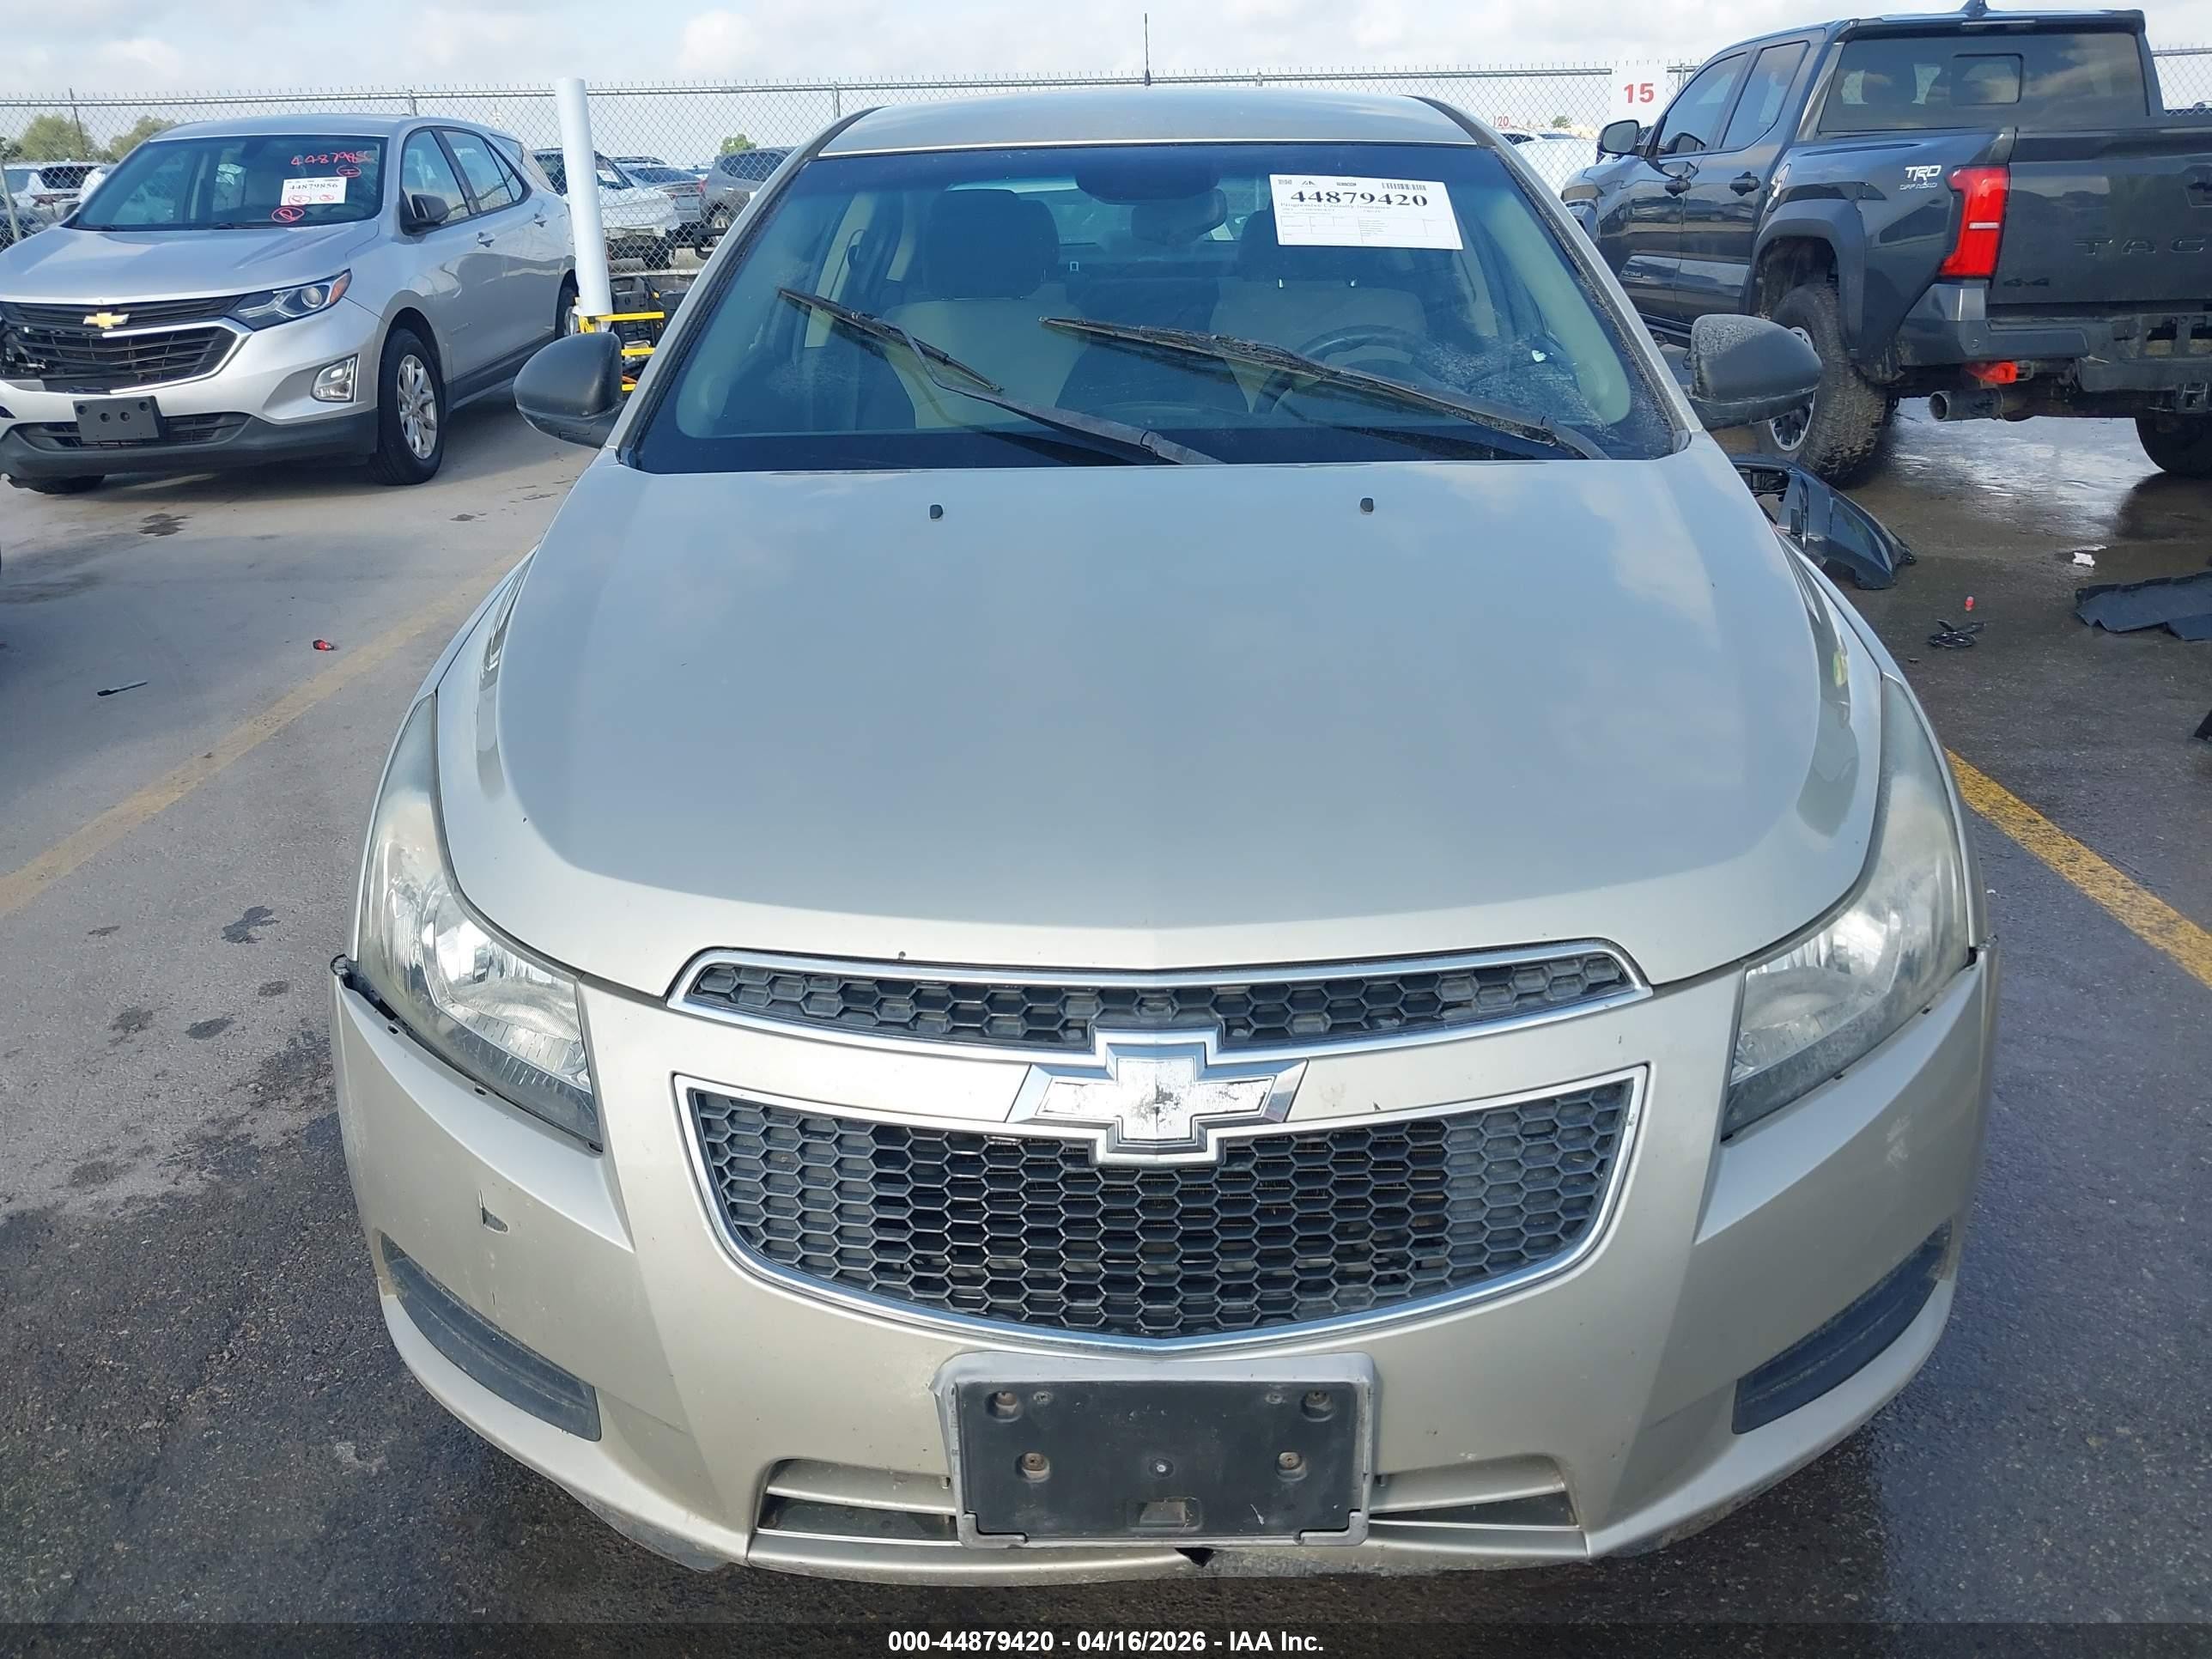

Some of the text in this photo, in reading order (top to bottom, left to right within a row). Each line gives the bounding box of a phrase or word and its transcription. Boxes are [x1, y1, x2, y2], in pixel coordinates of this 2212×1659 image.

[1624, 82, 1655, 104] 15
[1905, 165, 1942, 181] TRD
[1291, 191, 1428, 207] 44879420
